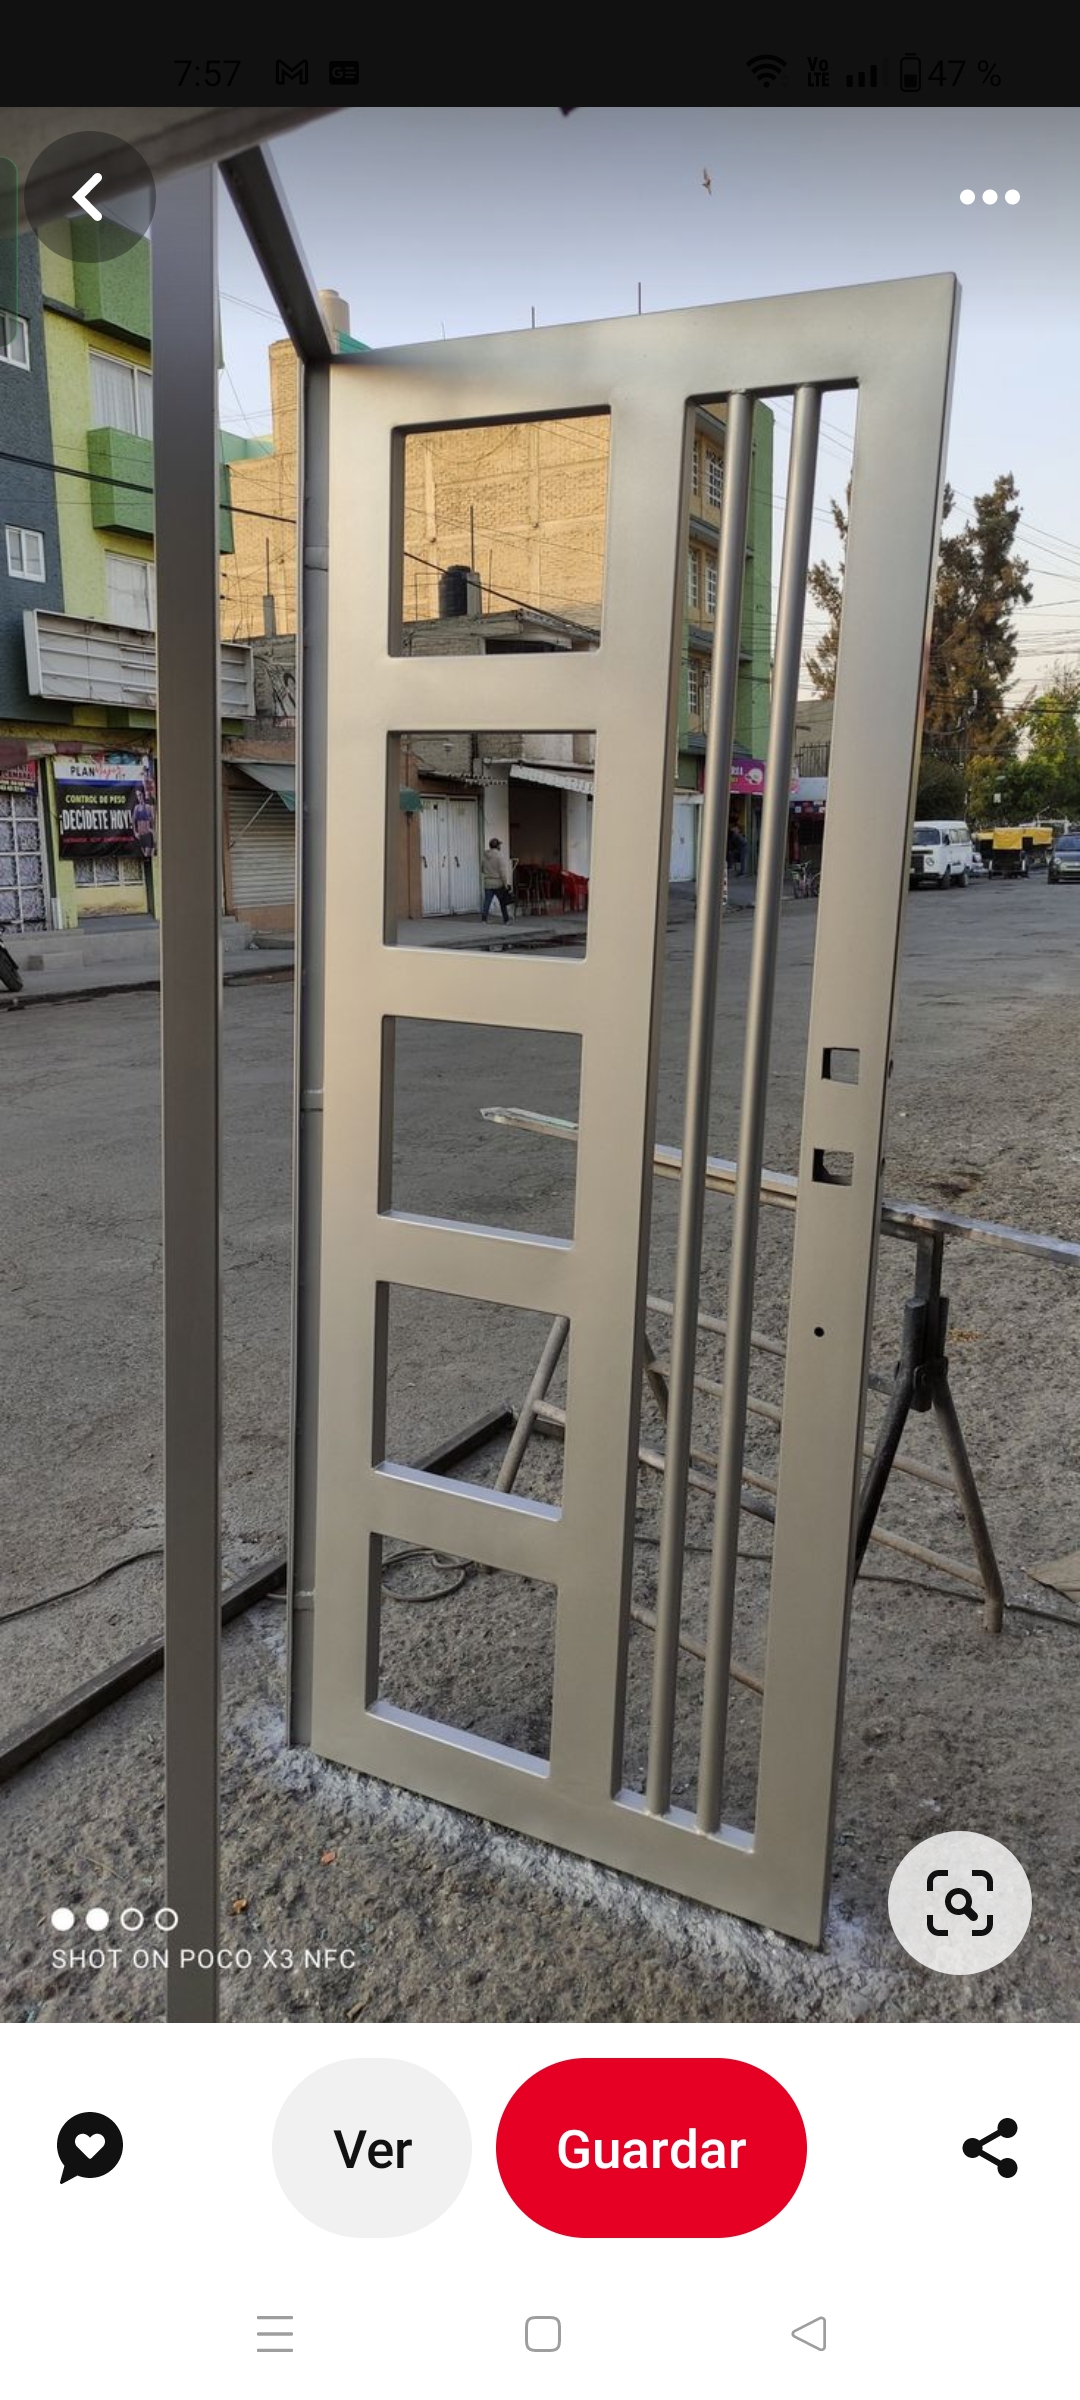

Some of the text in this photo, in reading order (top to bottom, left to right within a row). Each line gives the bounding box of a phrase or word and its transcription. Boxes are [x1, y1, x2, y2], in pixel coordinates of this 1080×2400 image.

[70, 765, 95, 777] PLAN
[65, 794, 126, 804] CONTROL DE PESO
[110, 809, 133, 830] HOY!
